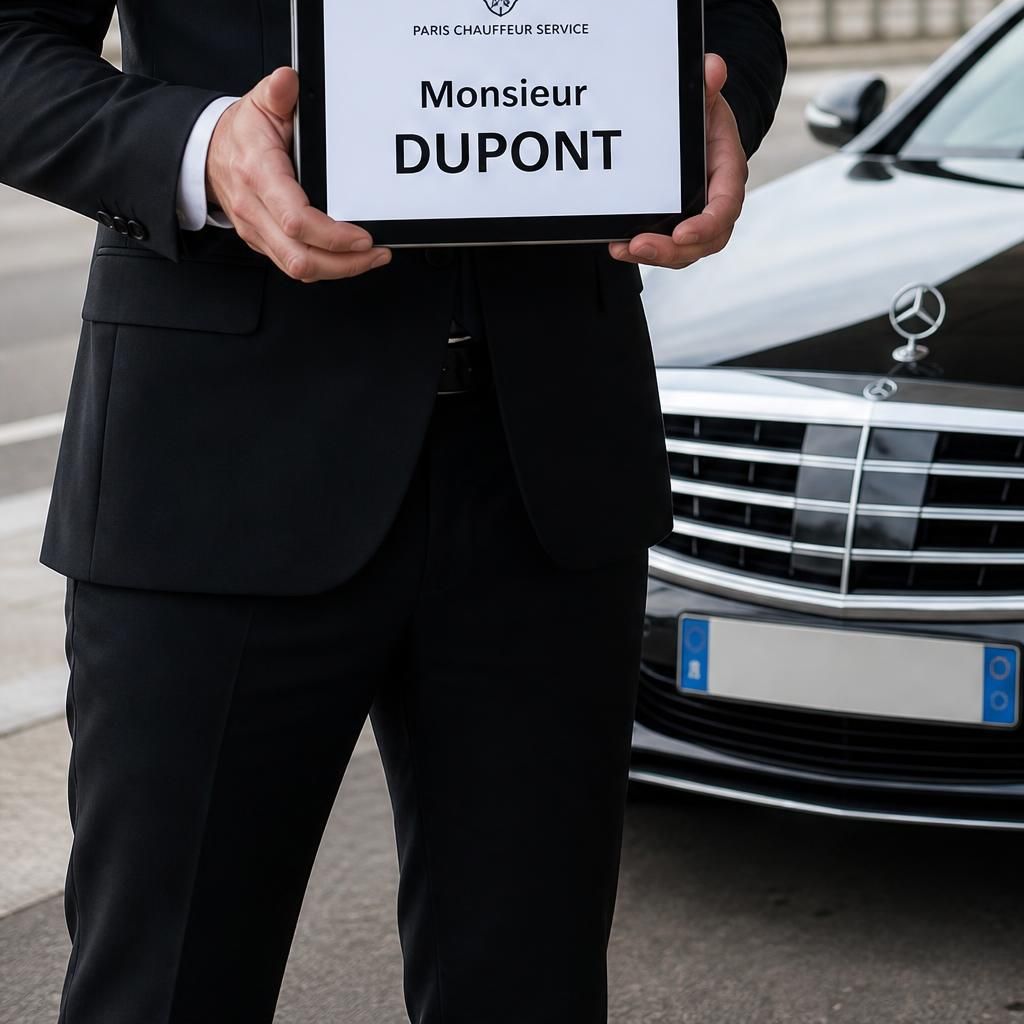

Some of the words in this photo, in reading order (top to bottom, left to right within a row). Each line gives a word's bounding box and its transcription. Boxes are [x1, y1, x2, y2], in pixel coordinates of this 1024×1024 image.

[413, 24, 450, 36] PARIS
[454, 24, 533, 36] CHAUFFEUR
[537, 23, 589, 35] SERVICE
[421, 78, 588, 109] Monsieur
[395, 129, 622, 175] DUPONT
